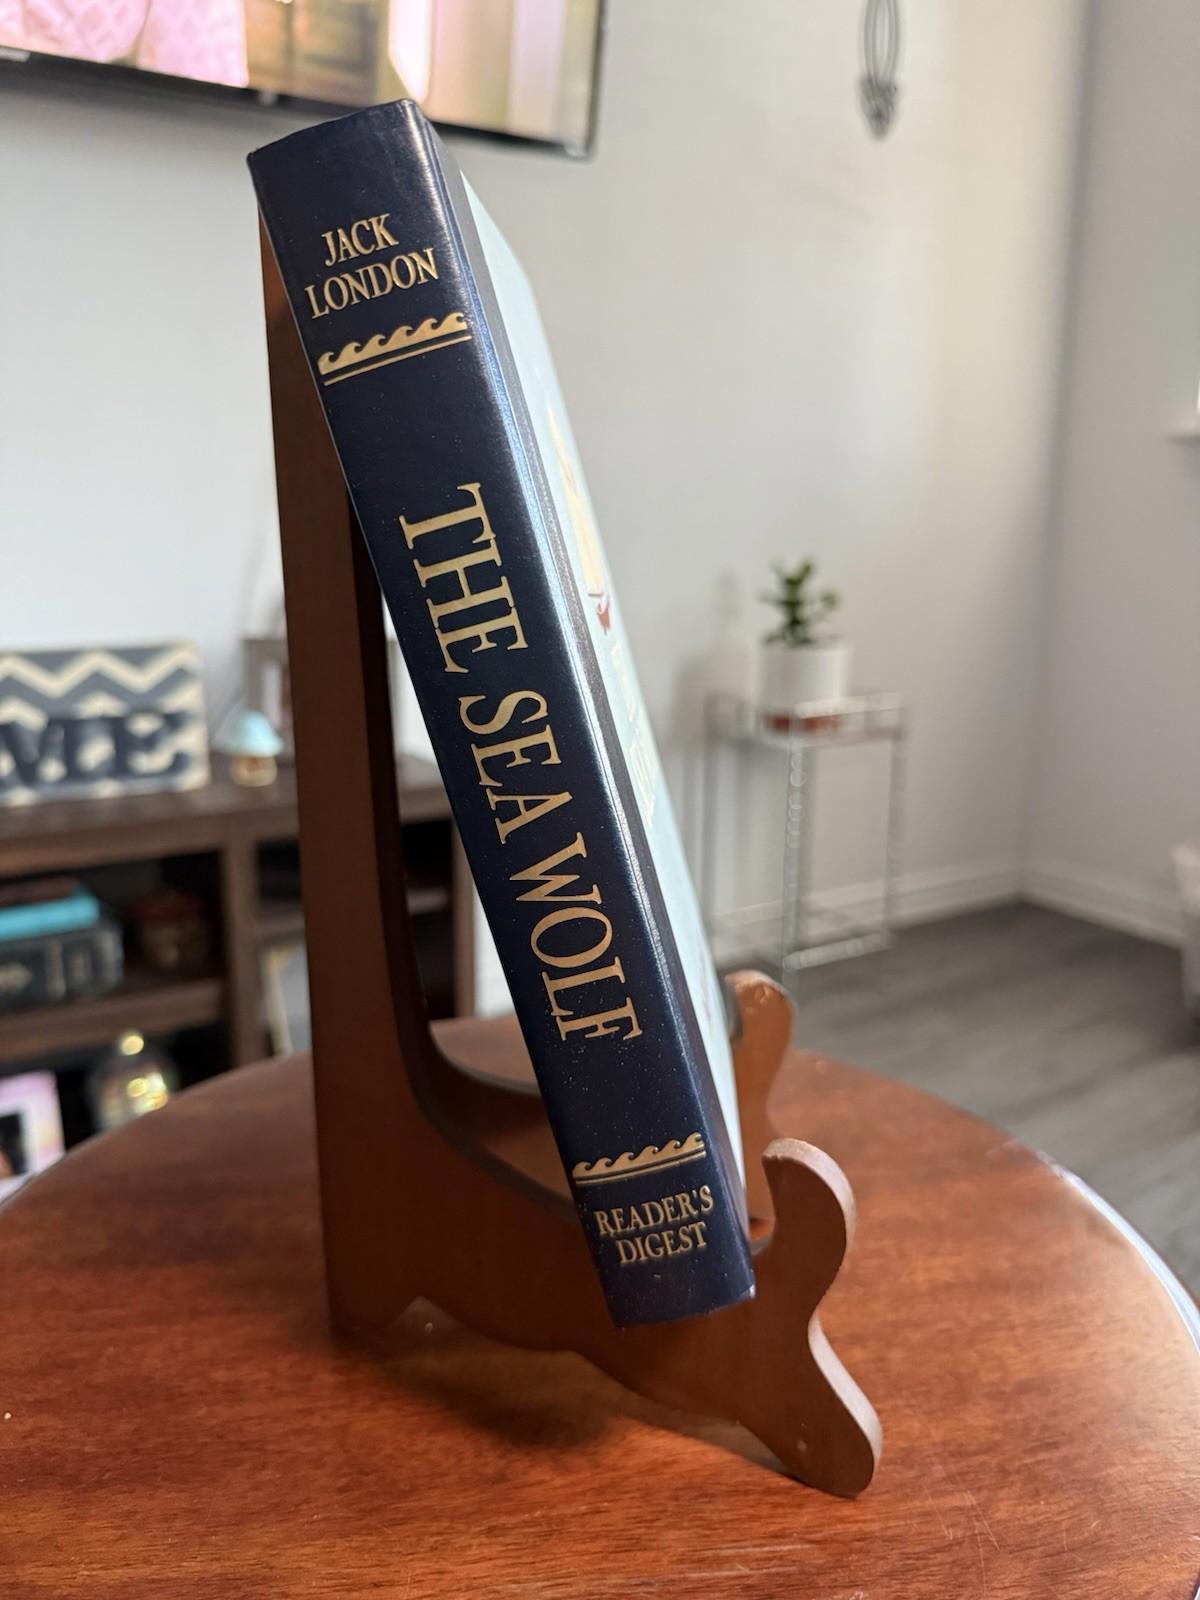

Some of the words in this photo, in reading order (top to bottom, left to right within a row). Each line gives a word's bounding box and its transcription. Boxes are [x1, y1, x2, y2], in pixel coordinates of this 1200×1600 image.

[321, 213, 399, 267] JACK
[304, 248, 439, 319] LONDON
[400, 482, 528, 673] THE
[459, 690, 573, 844] SEA
[509, 832, 643, 1040] WOLF
[594, 1185, 714, 1236] READER'S
[616, 1222, 707, 1264] DIGEST
